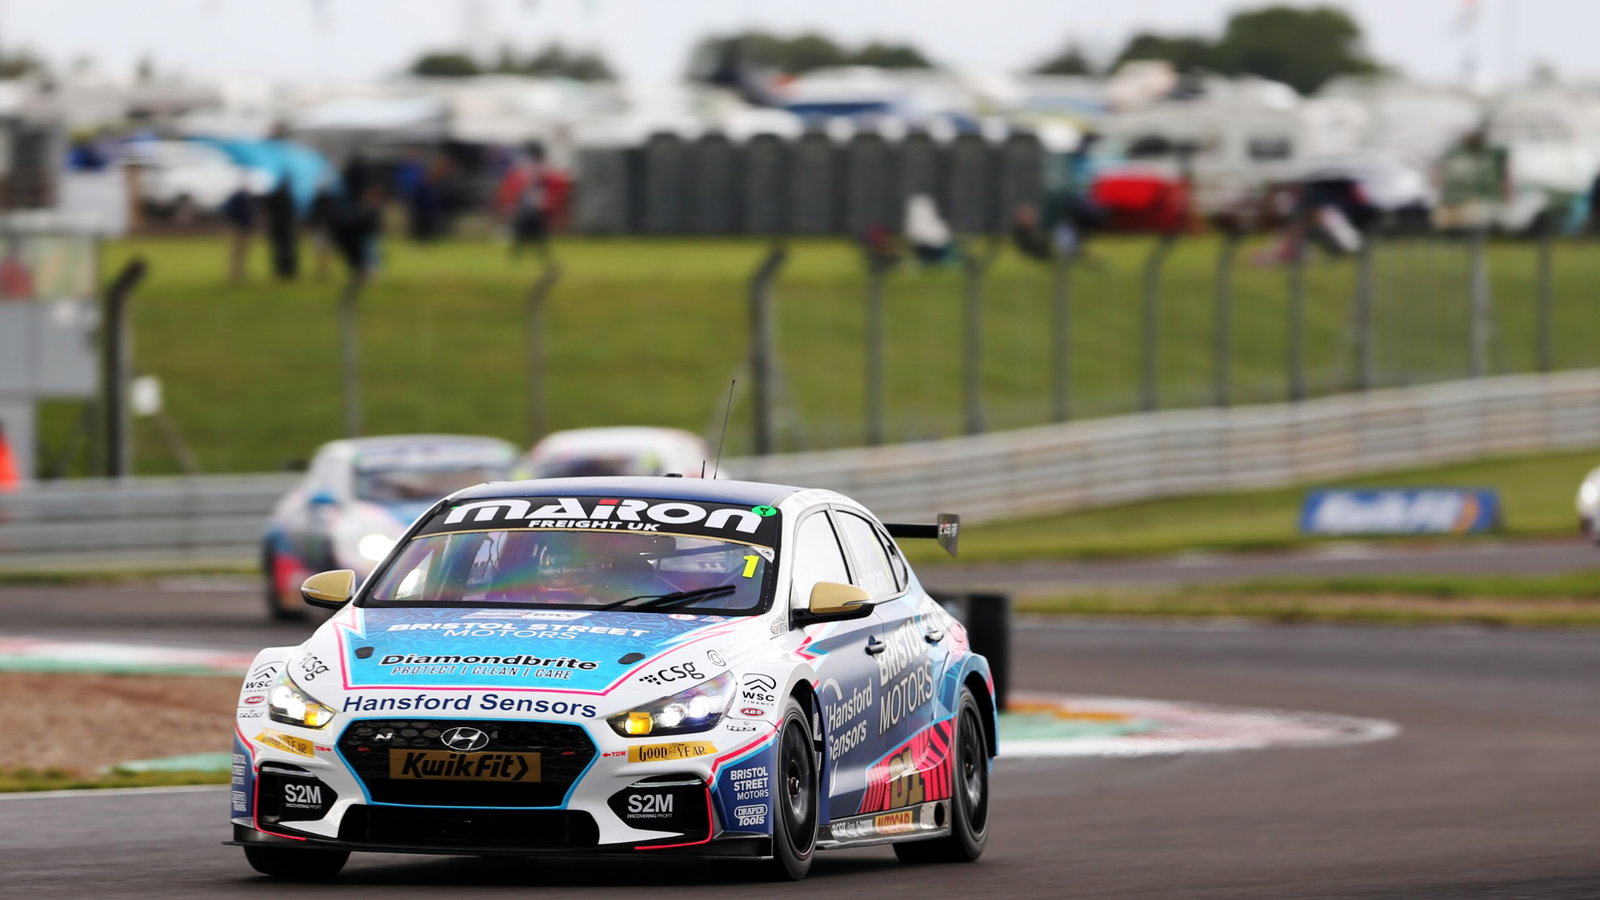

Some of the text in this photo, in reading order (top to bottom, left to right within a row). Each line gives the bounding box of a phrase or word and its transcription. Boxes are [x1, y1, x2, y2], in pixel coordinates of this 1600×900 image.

[528, 519, 661, 532] FREIGHT UK
[742, 554, 760, 578] 1
[386, 622, 650, 637] BRISTOL STREET
[443, 629, 579, 641] MOTORS
[380, 654, 599, 671] Diamondbrite
[391, 665, 458, 676] PROTECT
[472, 666, 519, 677] CLEAN
[535, 668, 573, 681] CARE
[656, 660, 706, 683] csg
[742, 691, 776, 702] WSC
[879, 660, 934, 735] MOTORS
[343, 694, 598, 719] Hansford Sensors
[828, 677, 873, 733] Hansford
[730, 766, 769, 781] BRISTOL
[733, 777, 769, 791] STREET
[284, 783, 323, 804] S2M
[736, 788, 770, 801] MOTORS
[627, 793, 674, 813] S2M
